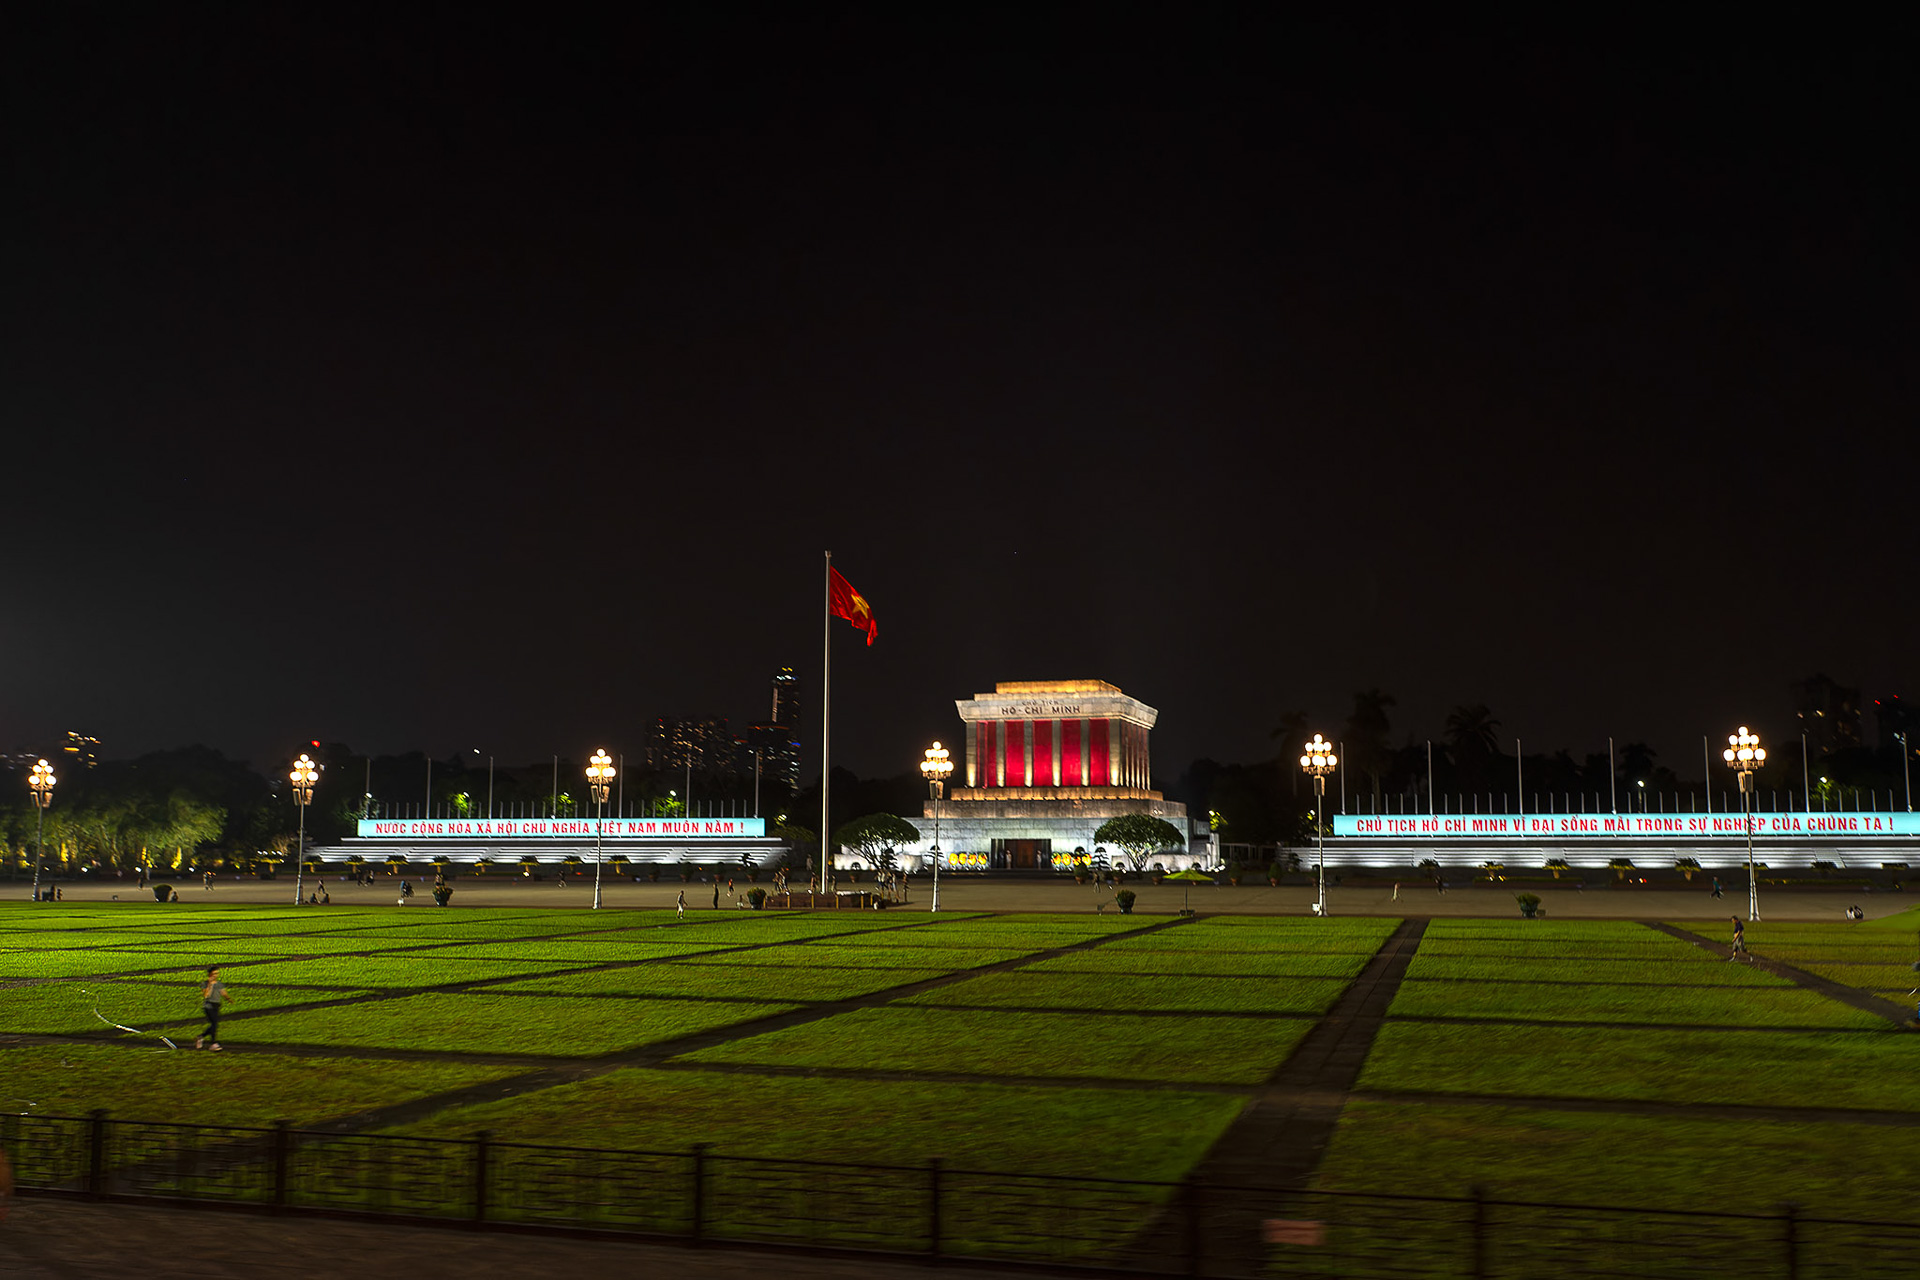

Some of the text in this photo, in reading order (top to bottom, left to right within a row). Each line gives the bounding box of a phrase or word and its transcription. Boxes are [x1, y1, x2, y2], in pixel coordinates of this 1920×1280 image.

[1052, 705, 1081, 714] MINH
[628, 822, 657, 834] NAM
[1387, 819, 1417, 835] TỊCH
[1472, 818, 1508, 832] MINH
[1531, 818, 1555, 835] ĐẠI
[1636, 818, 1683, 832] TRONG
[1863, 817, 1883, 831] TA
